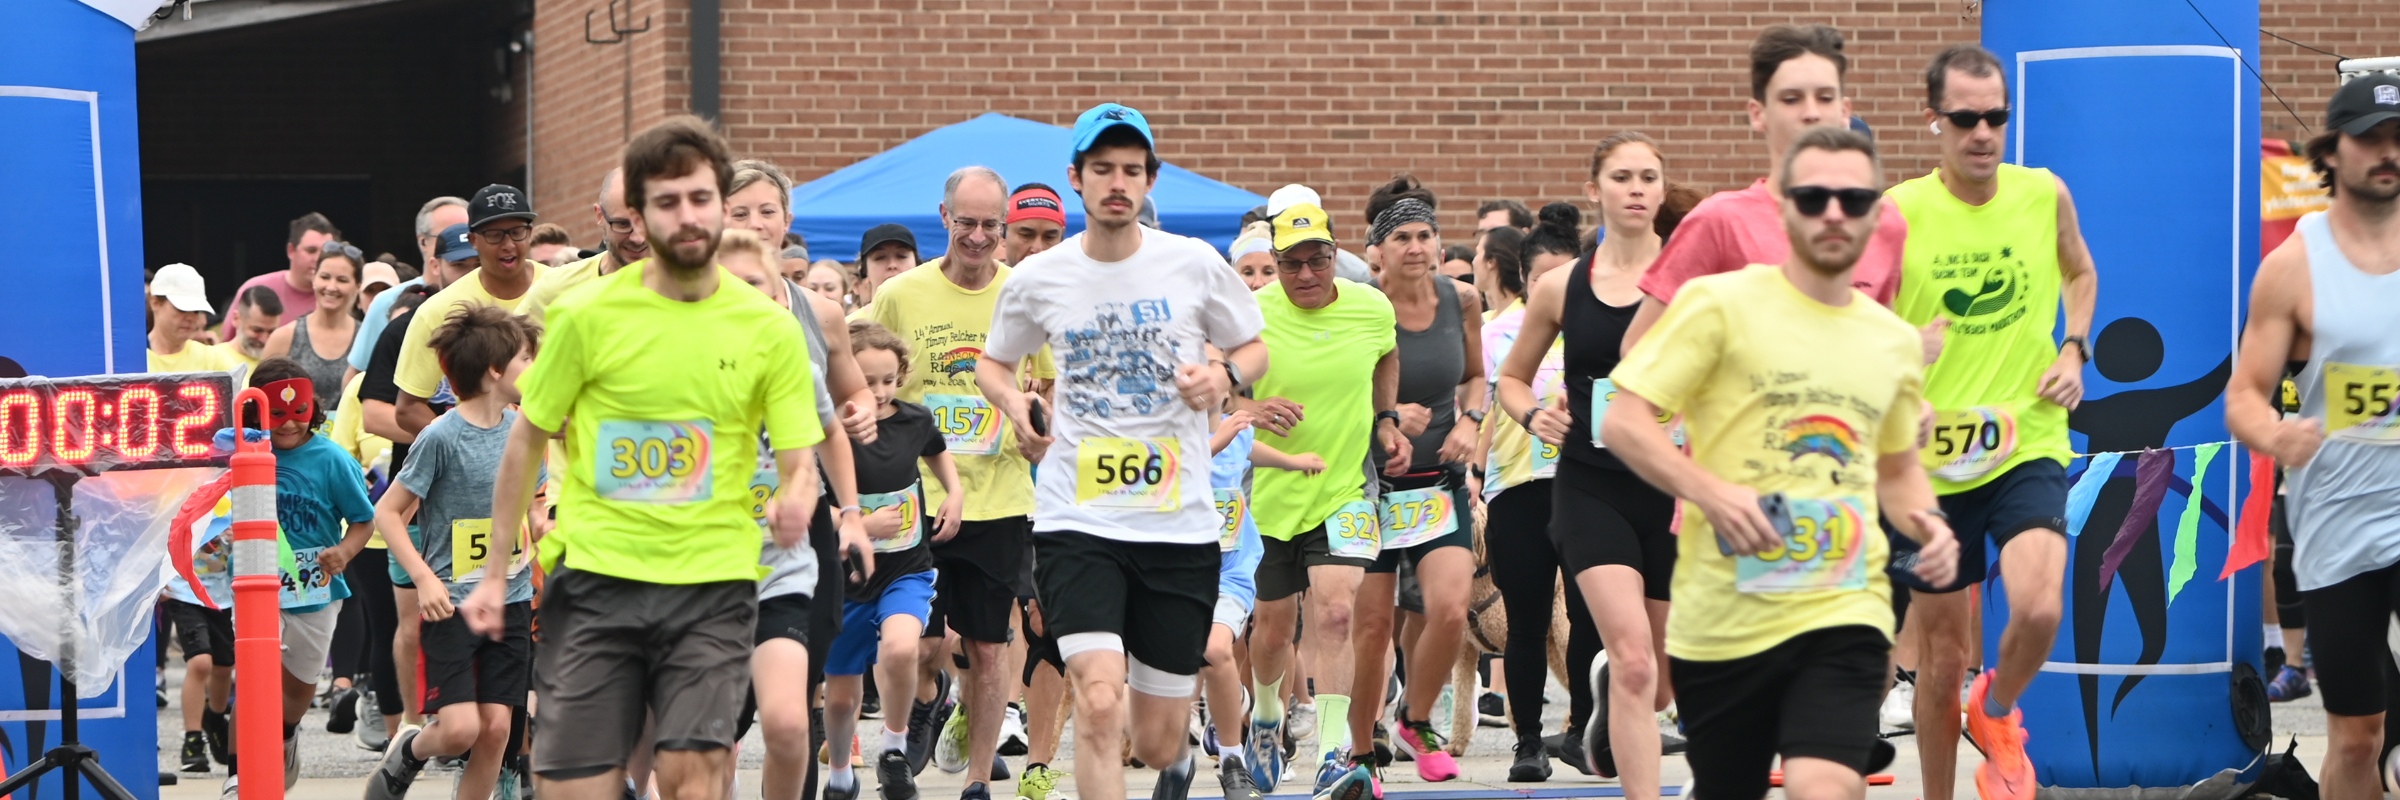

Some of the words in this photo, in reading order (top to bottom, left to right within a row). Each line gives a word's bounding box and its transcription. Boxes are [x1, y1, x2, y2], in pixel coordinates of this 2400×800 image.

[486, 192, 517, 208] FOX
[1138, 301, 1169, 322] 51
[925, 335, 948, 349] Timmy
[950, 330, 977, 343] Belcher
[928, 321, 953, 336] Annual
[930, 352, 976, 361] RAINBOW
[930, 362, 960, 373] Ride
[2344, 382, 2400, 417] 55
[0, 384, 216, 464] 00:02
[934, 405, 992, 436] 157
[1934, 420, 2000, 457] 570
[611, 436, 696, 479] 303
[1095, 453, 1163, 486] 566
[1388, 498, 1442, 531] 173
[469, 533, 522, 561] 51
[1755, 515, 1846, 563] 31
